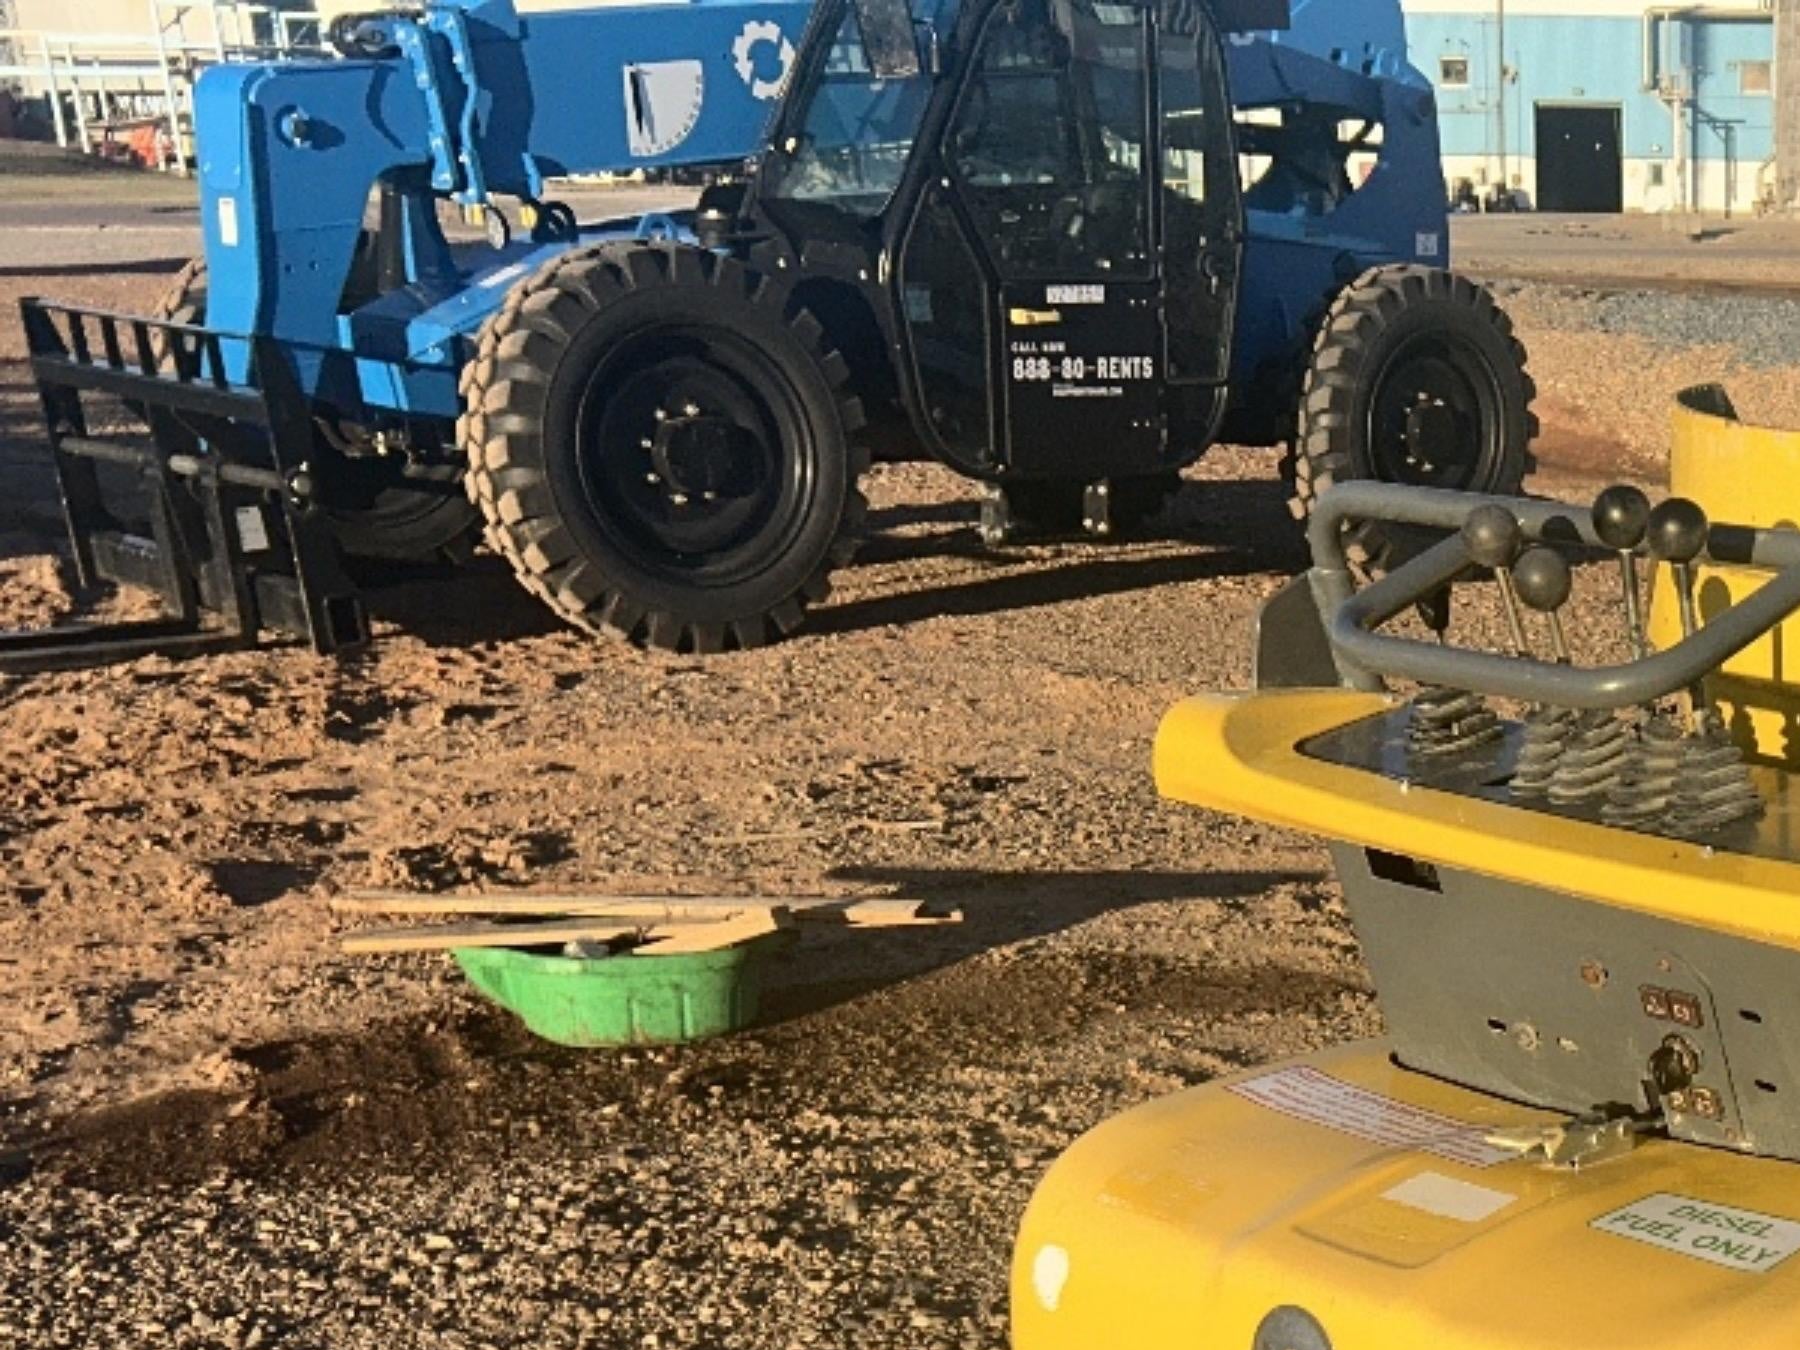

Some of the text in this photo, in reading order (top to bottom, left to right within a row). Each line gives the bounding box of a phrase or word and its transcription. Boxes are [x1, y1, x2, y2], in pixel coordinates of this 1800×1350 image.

[1607, 1211, 1781, 1265] FUEL ONLY
[1666, 1204, 1775, 1241] DIESEL
